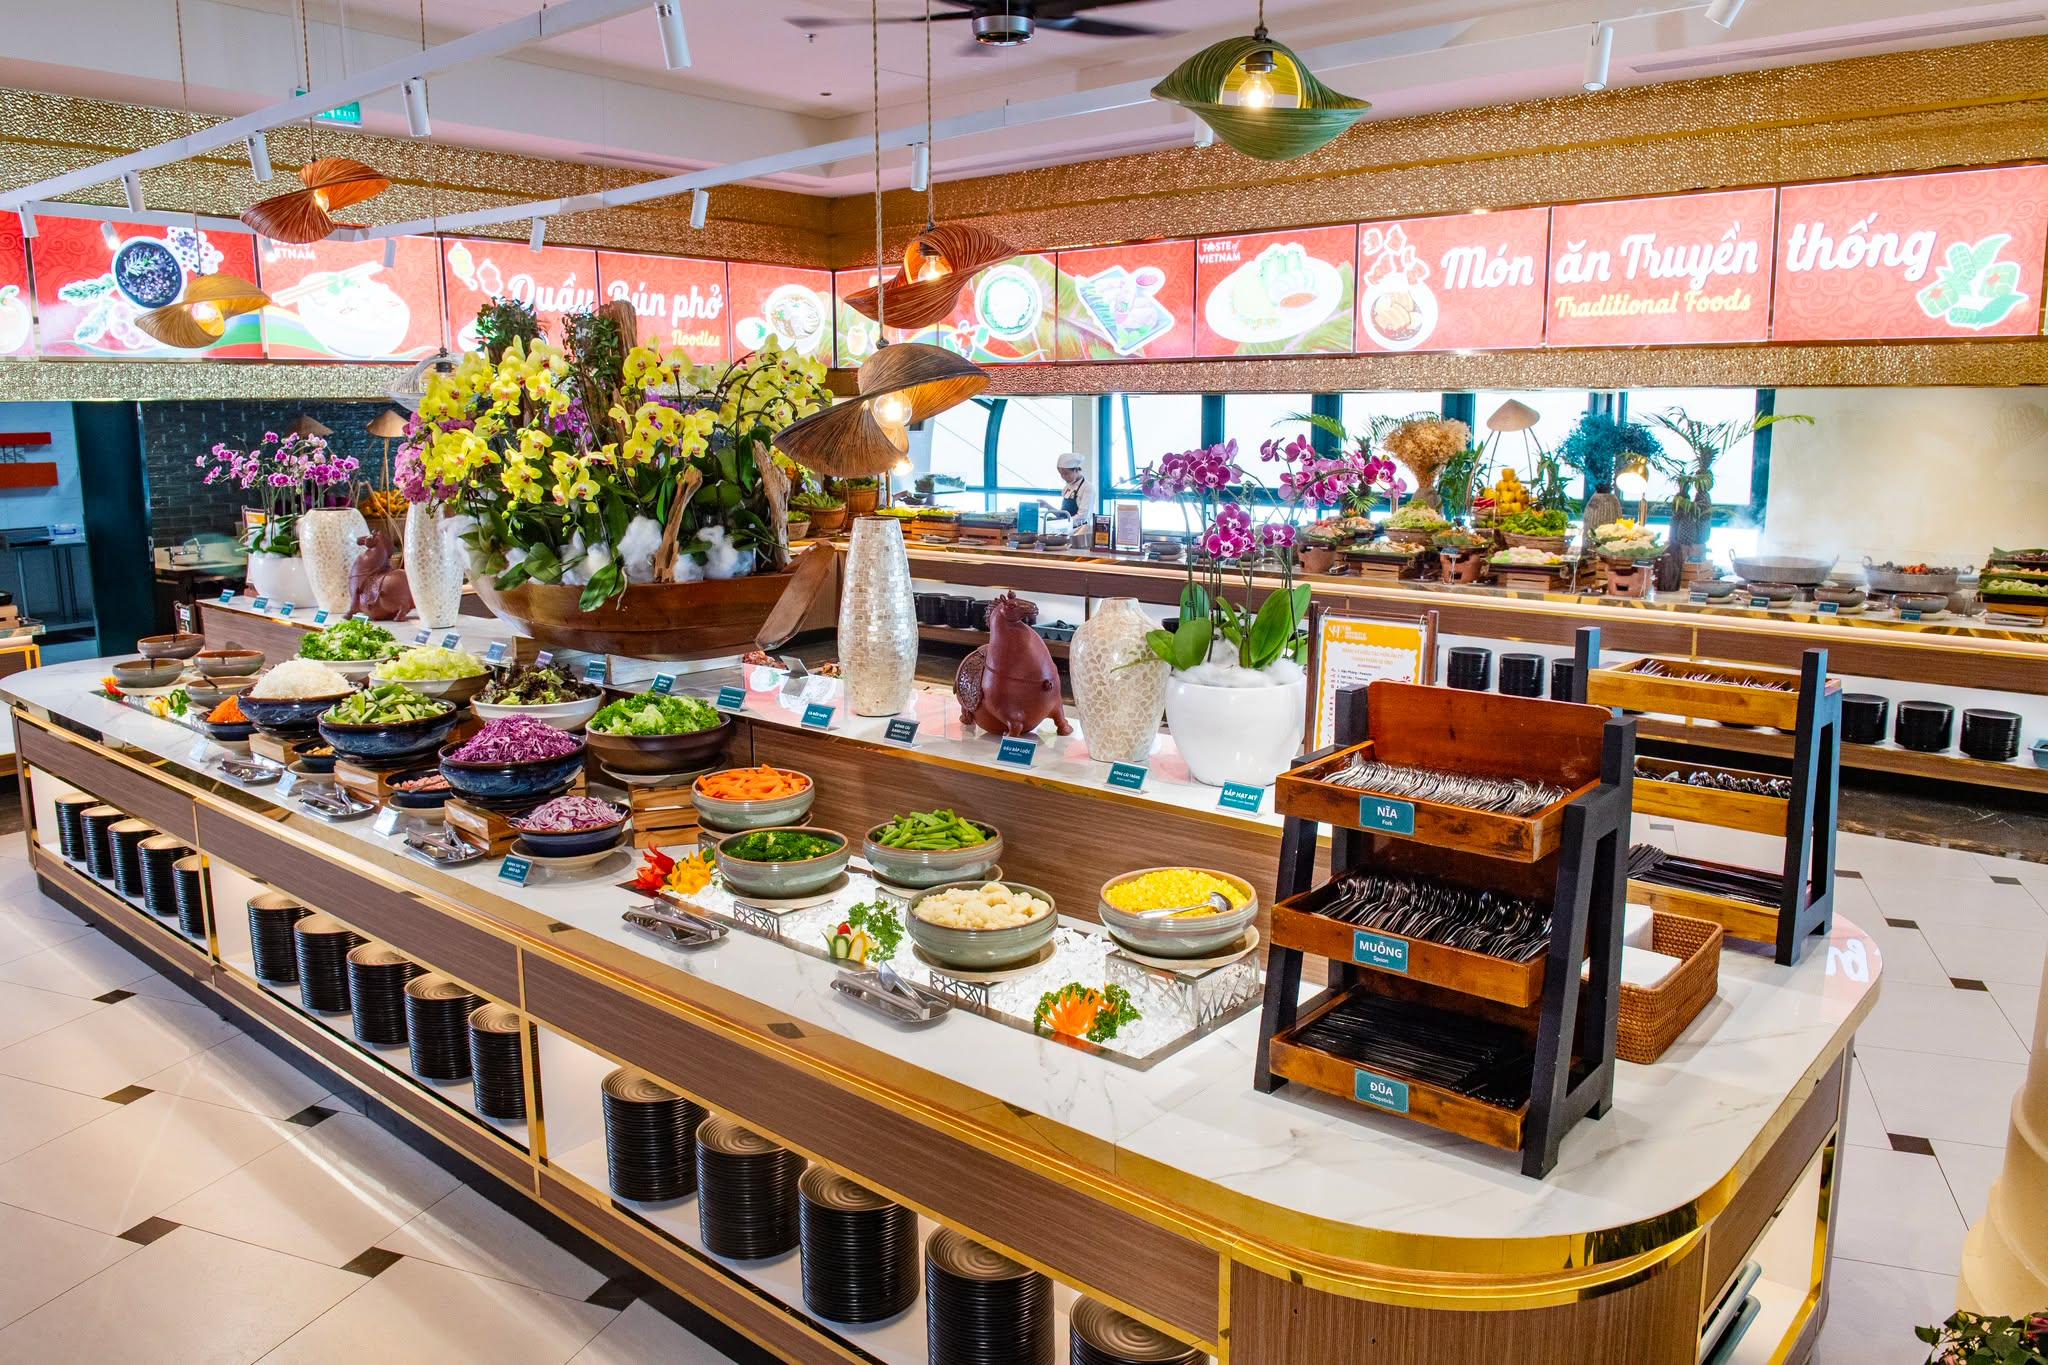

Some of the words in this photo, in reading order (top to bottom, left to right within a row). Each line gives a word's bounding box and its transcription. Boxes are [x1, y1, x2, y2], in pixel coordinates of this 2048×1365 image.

[1202, 241, 1232, 252] TASTE
[1441, 243, 1535, 290] Món
[1555, 239, 1612, 285] ăn
[1620, 221, 1759, 290] Truyền
[1786, 212, 1938, 282] thống
[1199, 251, 1241, 264] VIETNAM
[671, 284, 724, 328] phở
[1555, 290, 1680, 319] Traditional
[1684, 287, 1752, 314] Foods
[671, 328, 721, 347] Noodles
[1377, 805, 1398, 819] NĨA
[1370, 1082, 1393, 1097] ĐŨA
